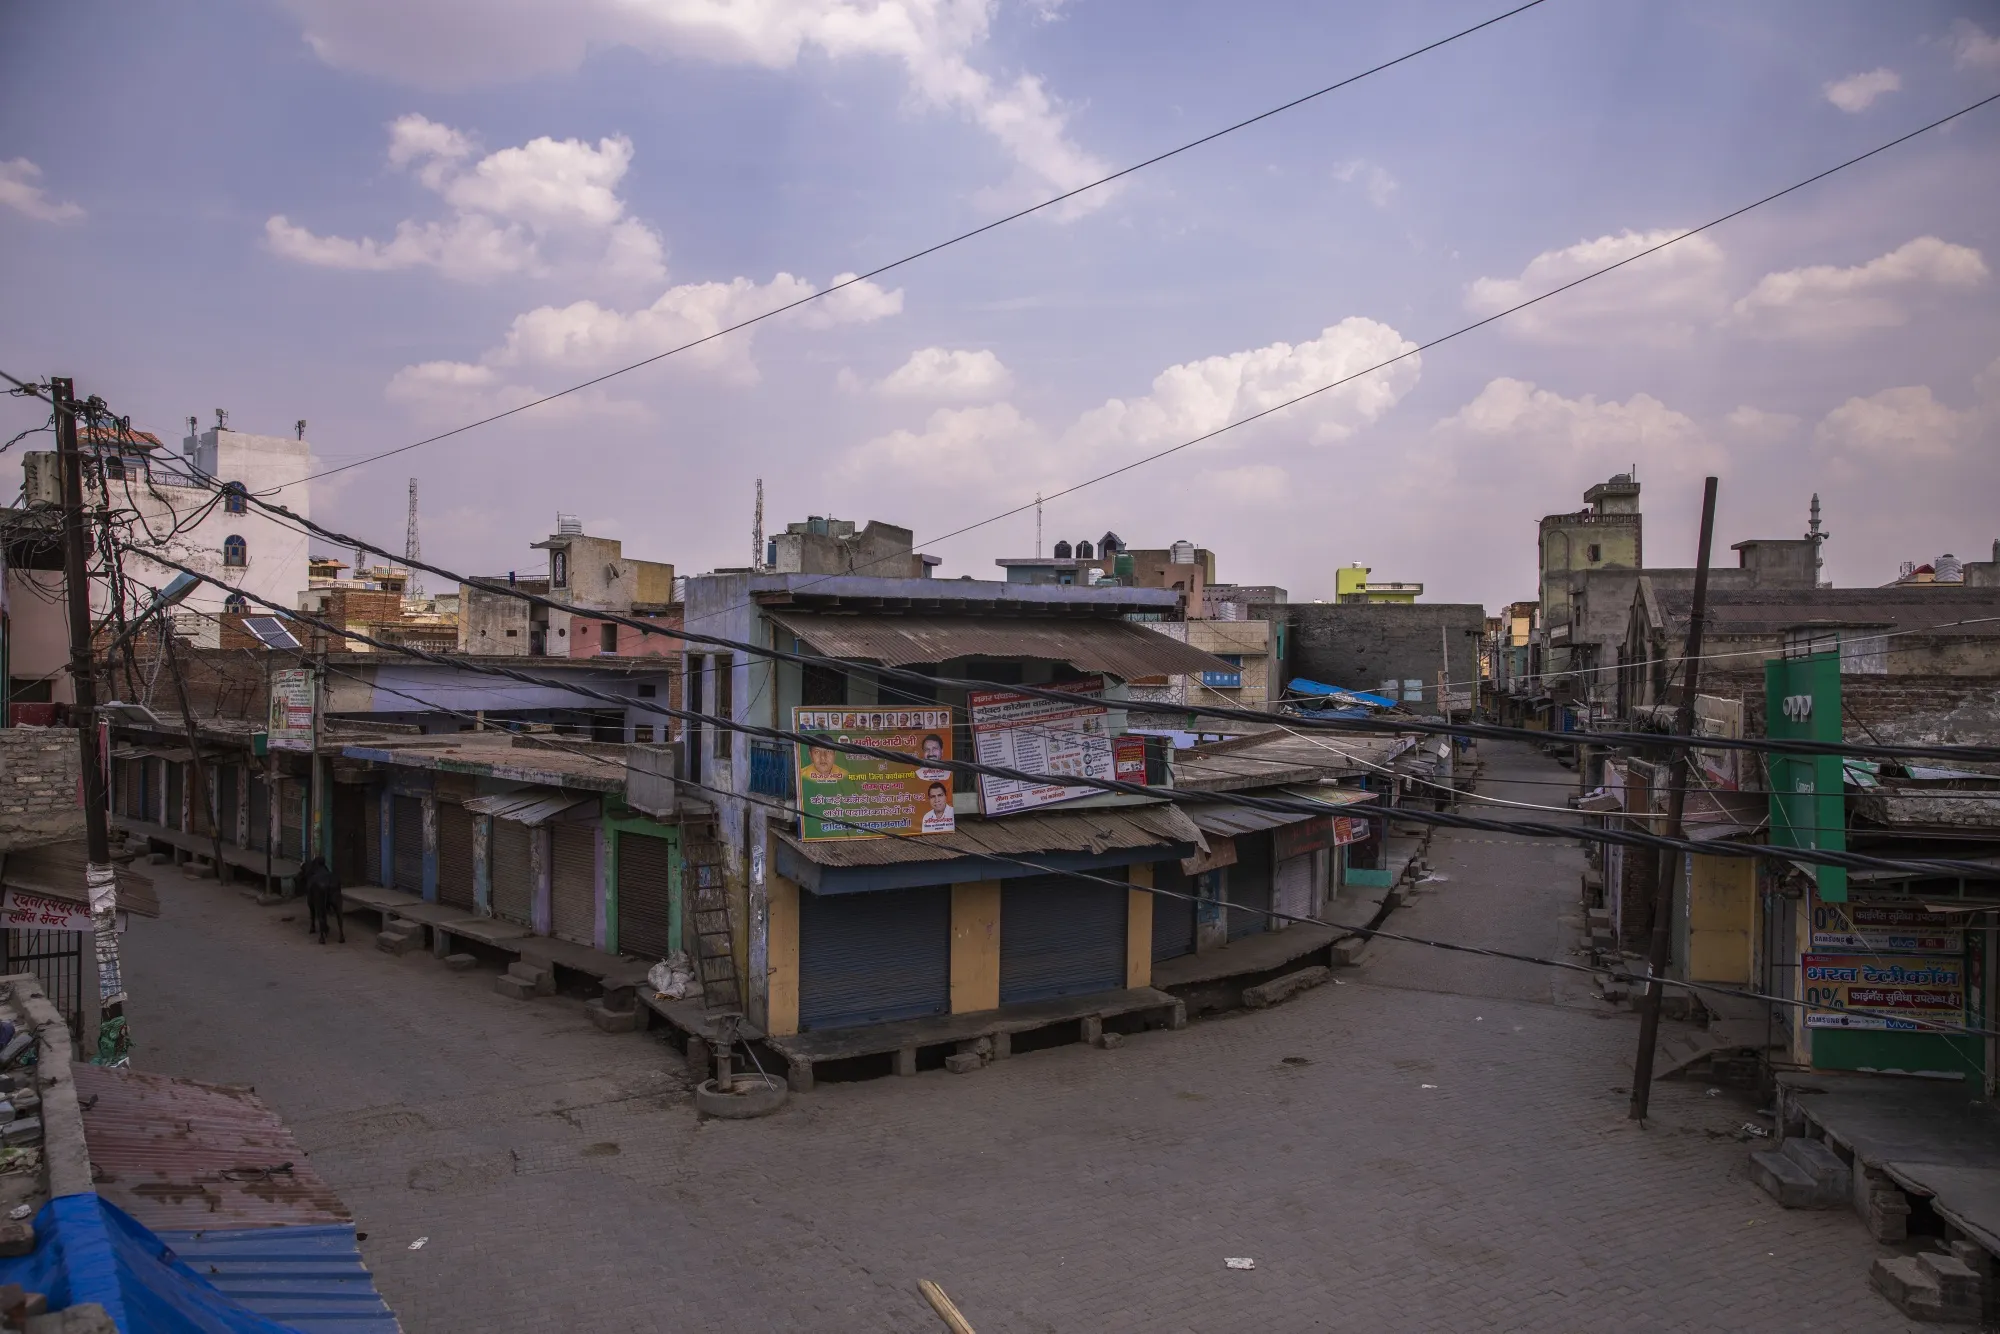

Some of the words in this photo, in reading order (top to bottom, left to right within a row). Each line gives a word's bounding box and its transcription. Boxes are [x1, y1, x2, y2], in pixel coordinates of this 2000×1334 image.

[1003, 702, 1030, 711] कोरोना
[1782, 694, 1812, 722] opp
[882, 735, 902, 746] भाटी
[904, 735, 916, 746] जी
[901, 805, 915, 815] को
[1815, 907, 1848, 931] 0%
[1814, 935, 1845, 943] SAMSUNG
[1890, 938, 1916, 947] vivo
[1806, 966, 1859, 983] भरत
[1860, 963, 1961, 987] टेलीकॉम
[1807, 986, 1843, 1011] 0%
[1886, 990, 1912, 1006] सुविधा
[1947, 994, 1960, 1006] है।
[1808, 1015, 1840, 1024] SAMSUNG
[1886, 1019, 1916, 1029] vivo
